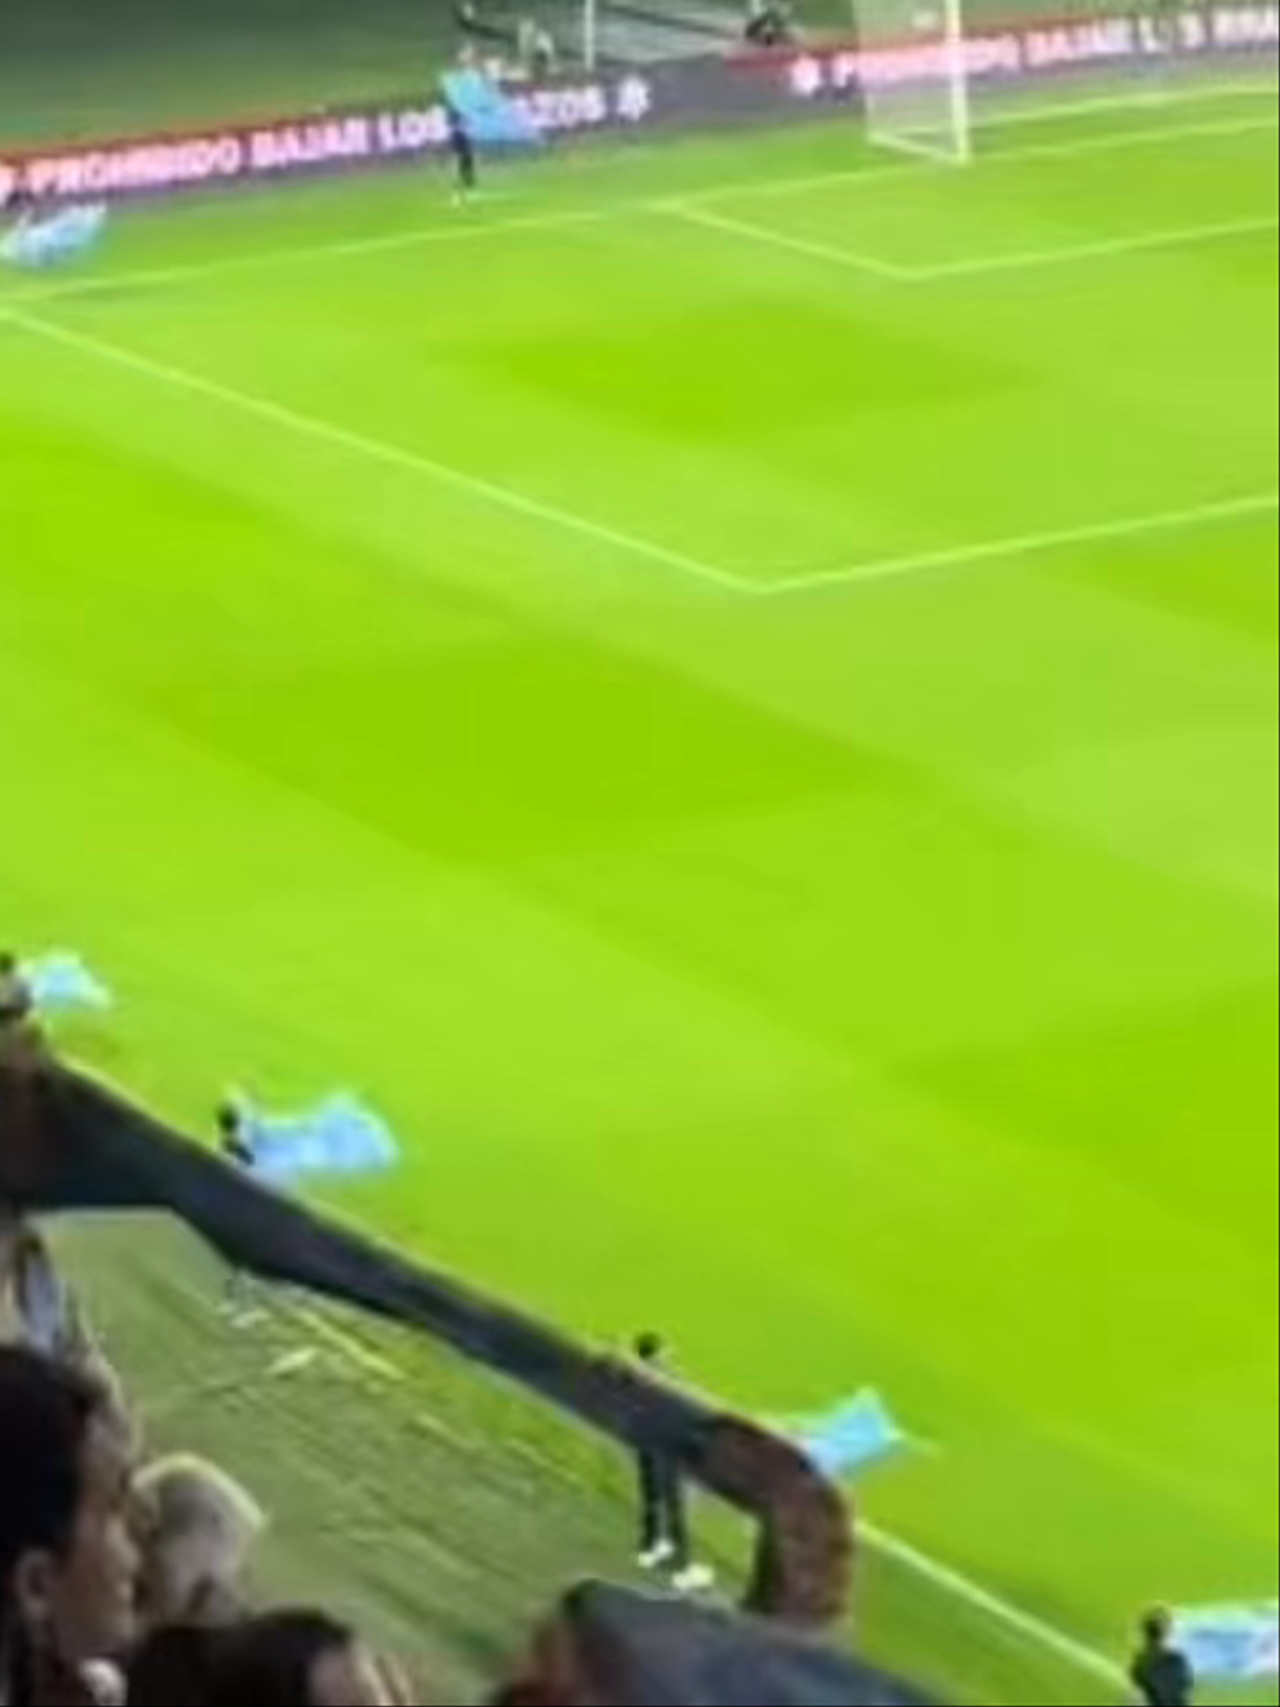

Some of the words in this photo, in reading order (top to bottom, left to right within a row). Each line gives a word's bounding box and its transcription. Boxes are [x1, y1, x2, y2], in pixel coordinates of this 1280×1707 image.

[1139, 12, 1204, 52] LS
[26, 137, 242, 194] PROHIBIDO
[251, 117, 368, 168] BAJAR
[378, 104, 449, 151] LOS
